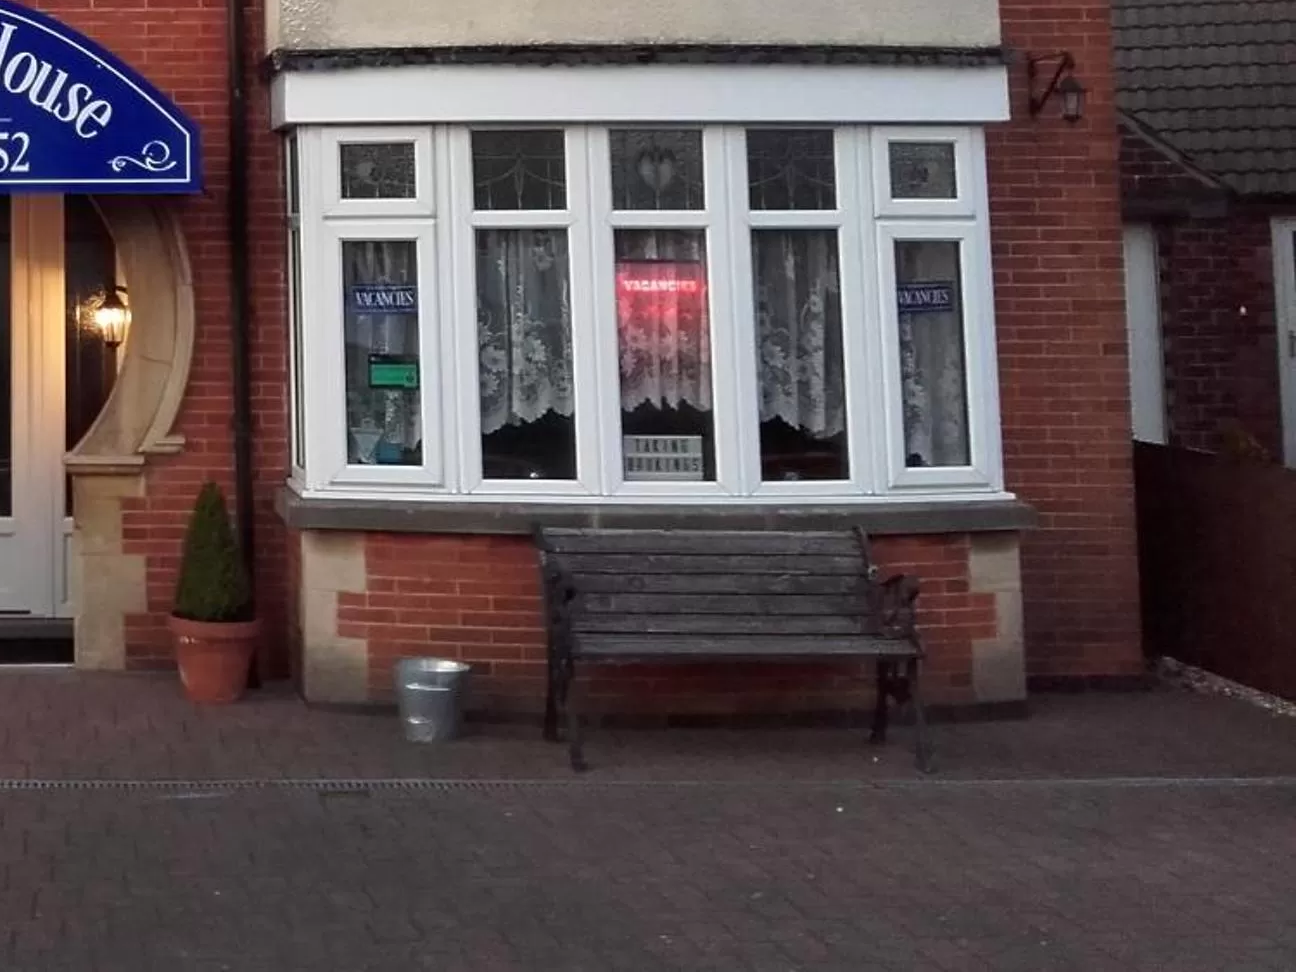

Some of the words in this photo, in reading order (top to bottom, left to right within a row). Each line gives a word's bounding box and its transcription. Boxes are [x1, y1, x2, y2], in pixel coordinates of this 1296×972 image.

[355, 291, 414, 306] VACANCIES
[635, 438, 689, 453] TAKING
[627, 456, 700, 472] BOOKINGS
